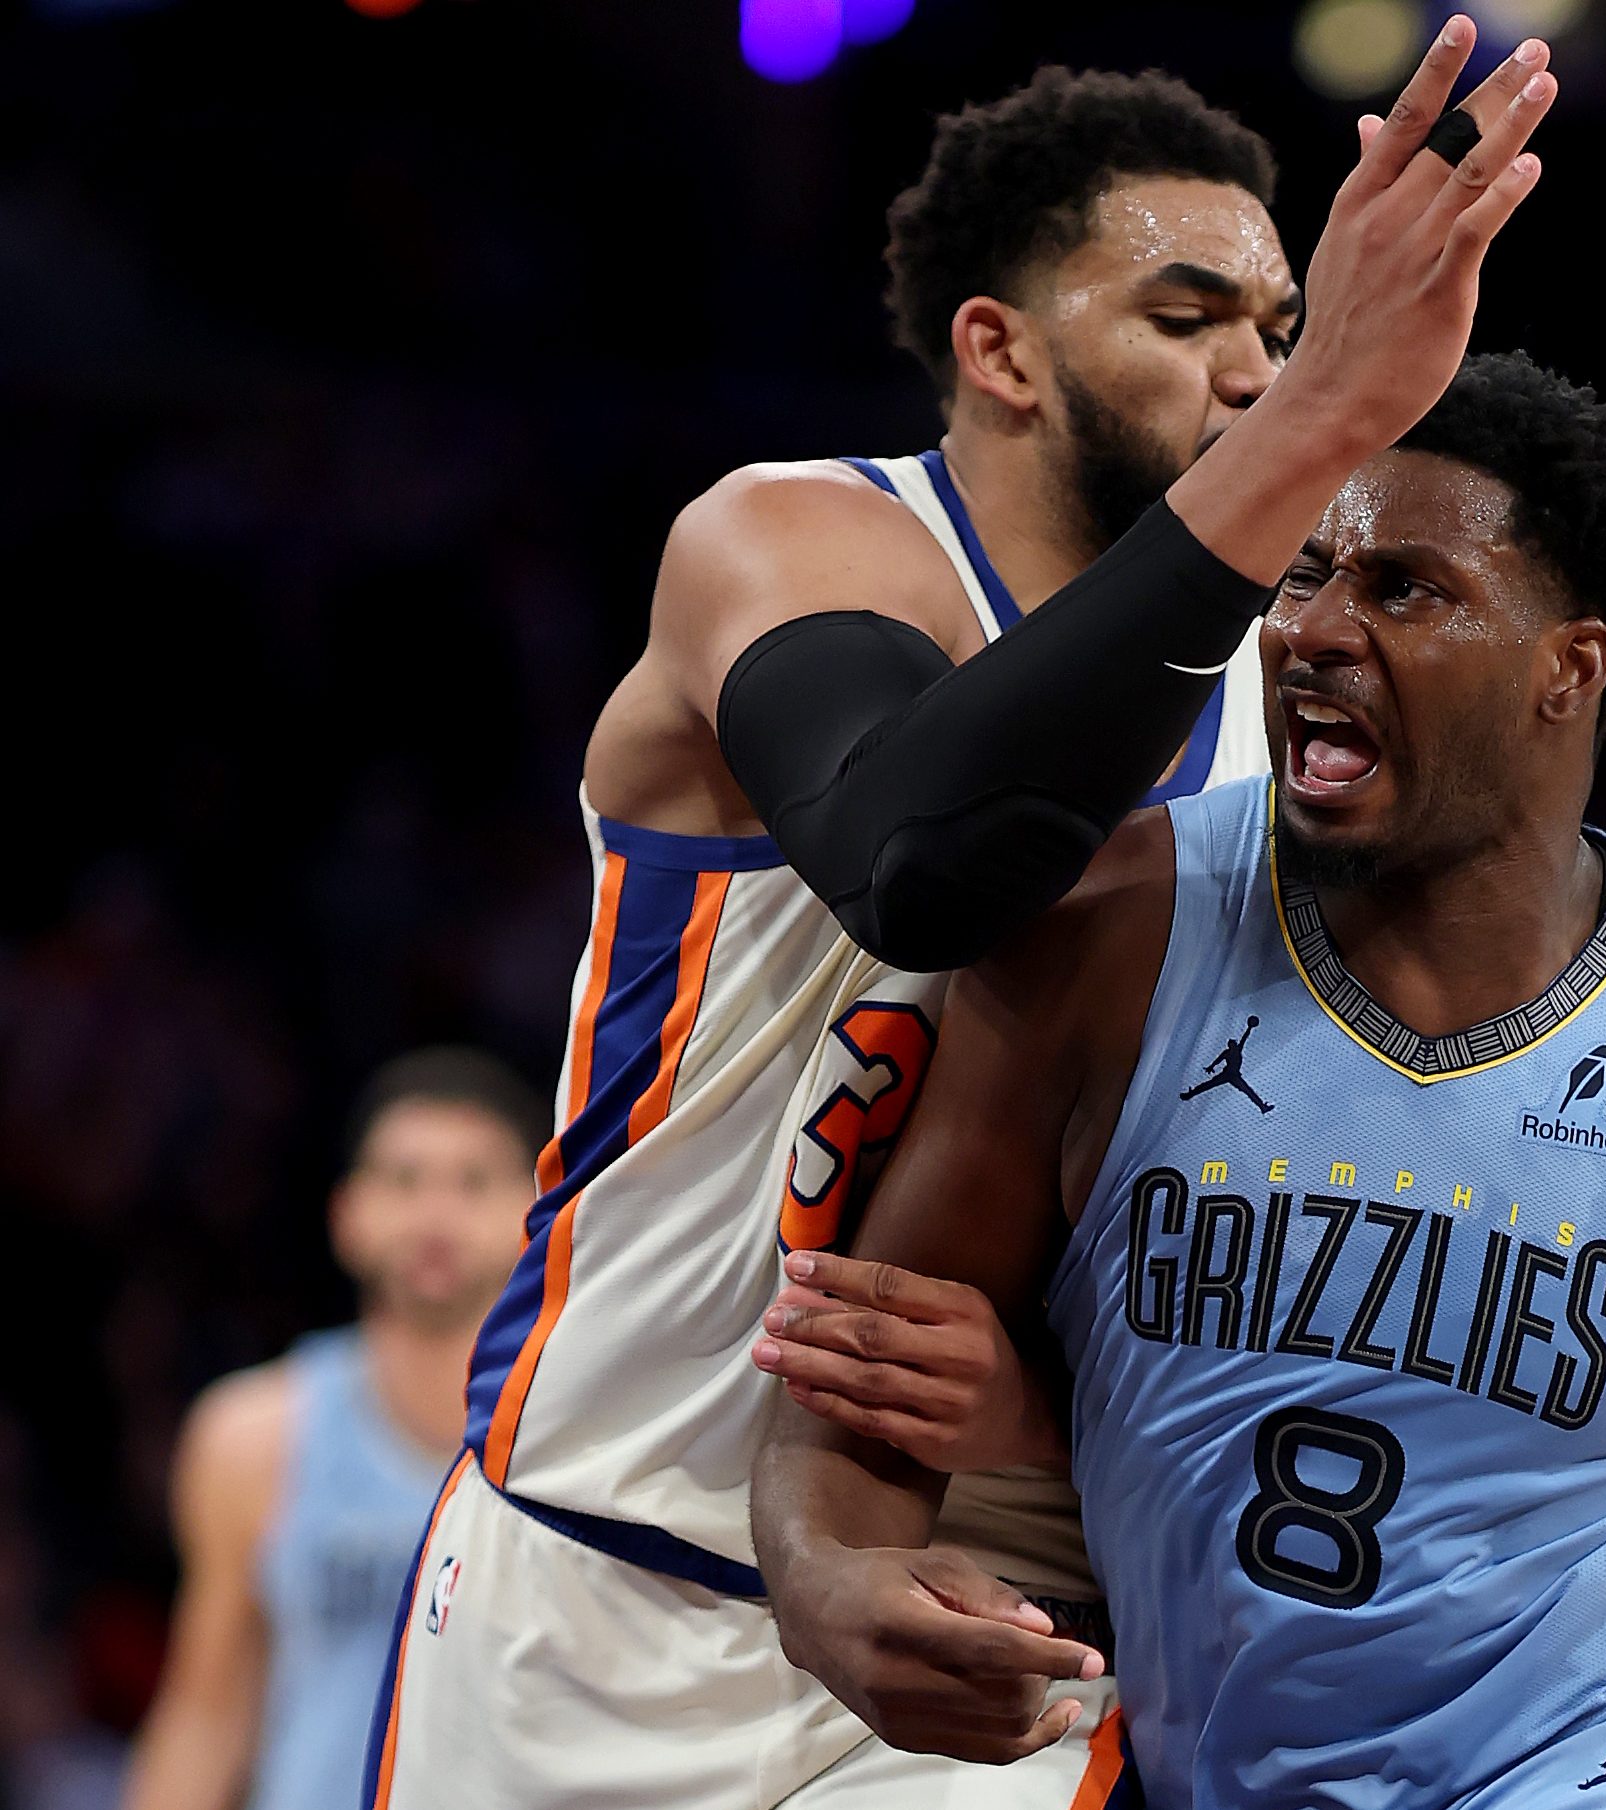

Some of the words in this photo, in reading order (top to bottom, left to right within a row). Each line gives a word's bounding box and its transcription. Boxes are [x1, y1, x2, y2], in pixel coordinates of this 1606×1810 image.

[777, 1001, 938, 1256] 3
[1200, 1158, 1576, 1247] MEMPHIS
[1236, 1406, 1406, 1610] 8
